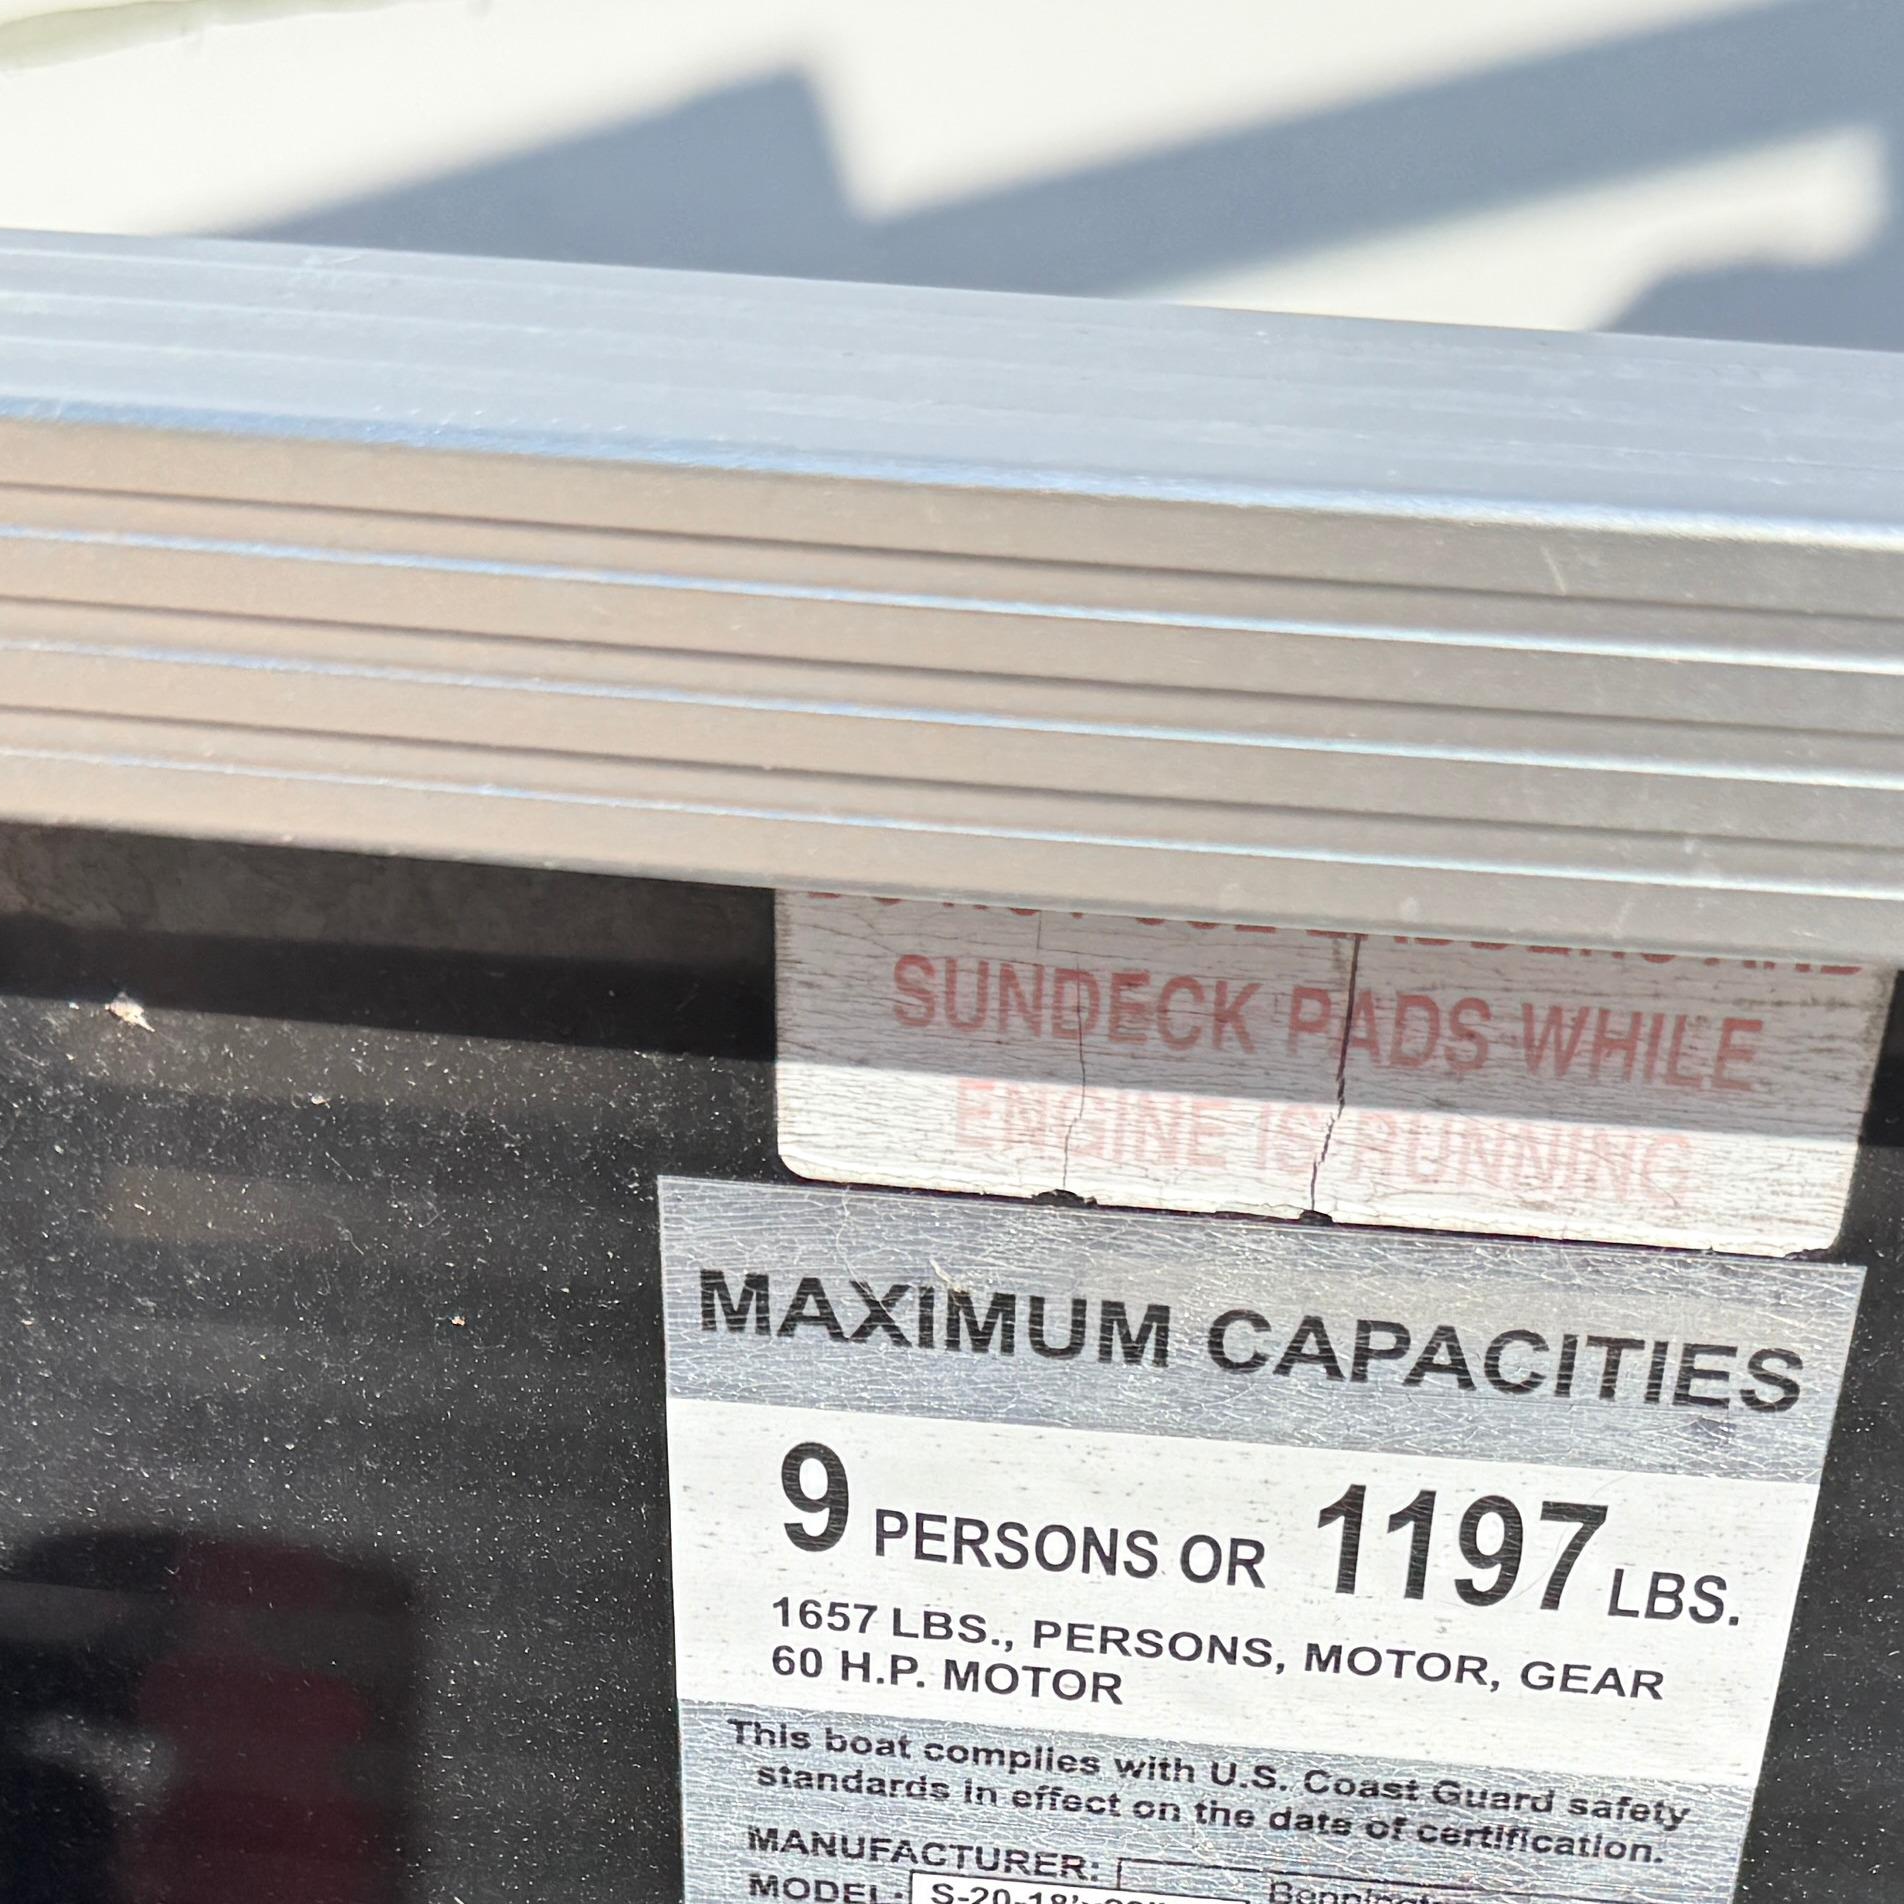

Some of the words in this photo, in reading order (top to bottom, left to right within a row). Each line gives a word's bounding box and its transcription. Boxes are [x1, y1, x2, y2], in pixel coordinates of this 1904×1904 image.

[893, 953, 1262, 1054] SUNDECK
[1287, 985, 1493, 1073] PADS
[1521, 1000, 1764, 1092] WHILE
[954, 1077, 1230, 1171] ENGINE
[1256, 1101, 1322, 1177] IS
[1348, 1109, 1691, 1209] RUNNING
[698, 1268, 1172, 1369] MAXIMUM
[1206, 1308, 1805, 1414] CAPACITIES
[780, 1441, 850, 1553] 9
[874, 1507, 1160, 1580] PERSONS
[1179, 1534, 1267, 1590] OR
[1316, 1483, 1609, 1612] 1197
[1607, 1567, 1740, 1627] LBS.
[771, 1596, 879, 1635] 1657
[891, 1606, 1014, 1653] LBS.,
[1032, 1619, 1286, 1676] PERSONS,
[1303, 1642, 1500, 1693] MOTOR,
[1519, 1661, 1665, 1701] GEAR
[771, 1644, 823, 1678] 60
[841, 1650, 925, 1690] H.P.
[943, 1658, 1124, 1706] MOTOR
[727, 1717, 811, 1751] This
[825, 1725, 912, 1761] boat
[923, 1741, 1102, 1777] complies
[1113, 1753, 1196, 1785] with
[1210, 1761, 1288, 1793] U.S.
[1303, 1768, 1420, 1803] Coast
[1431, 1779, 1555, 1814] Guard
[1568, 1794, 1692, 1833] safety
[757, 1764, 951, 1802] standards
[964, 1777, 998, 1805] in
[1011, 1783, 1122, 1818] effect
[1132, 1798, 1181, 1822] on
[1194, 1798, 1256, 1828] the
[1268, 1806, 1352, 1838] date
[1365, 1814, 1410, 1841] of
[1416, 1821, 1665, 1865] certification.
[747, 1824, 1102, 1882] MANUFACTURER:
